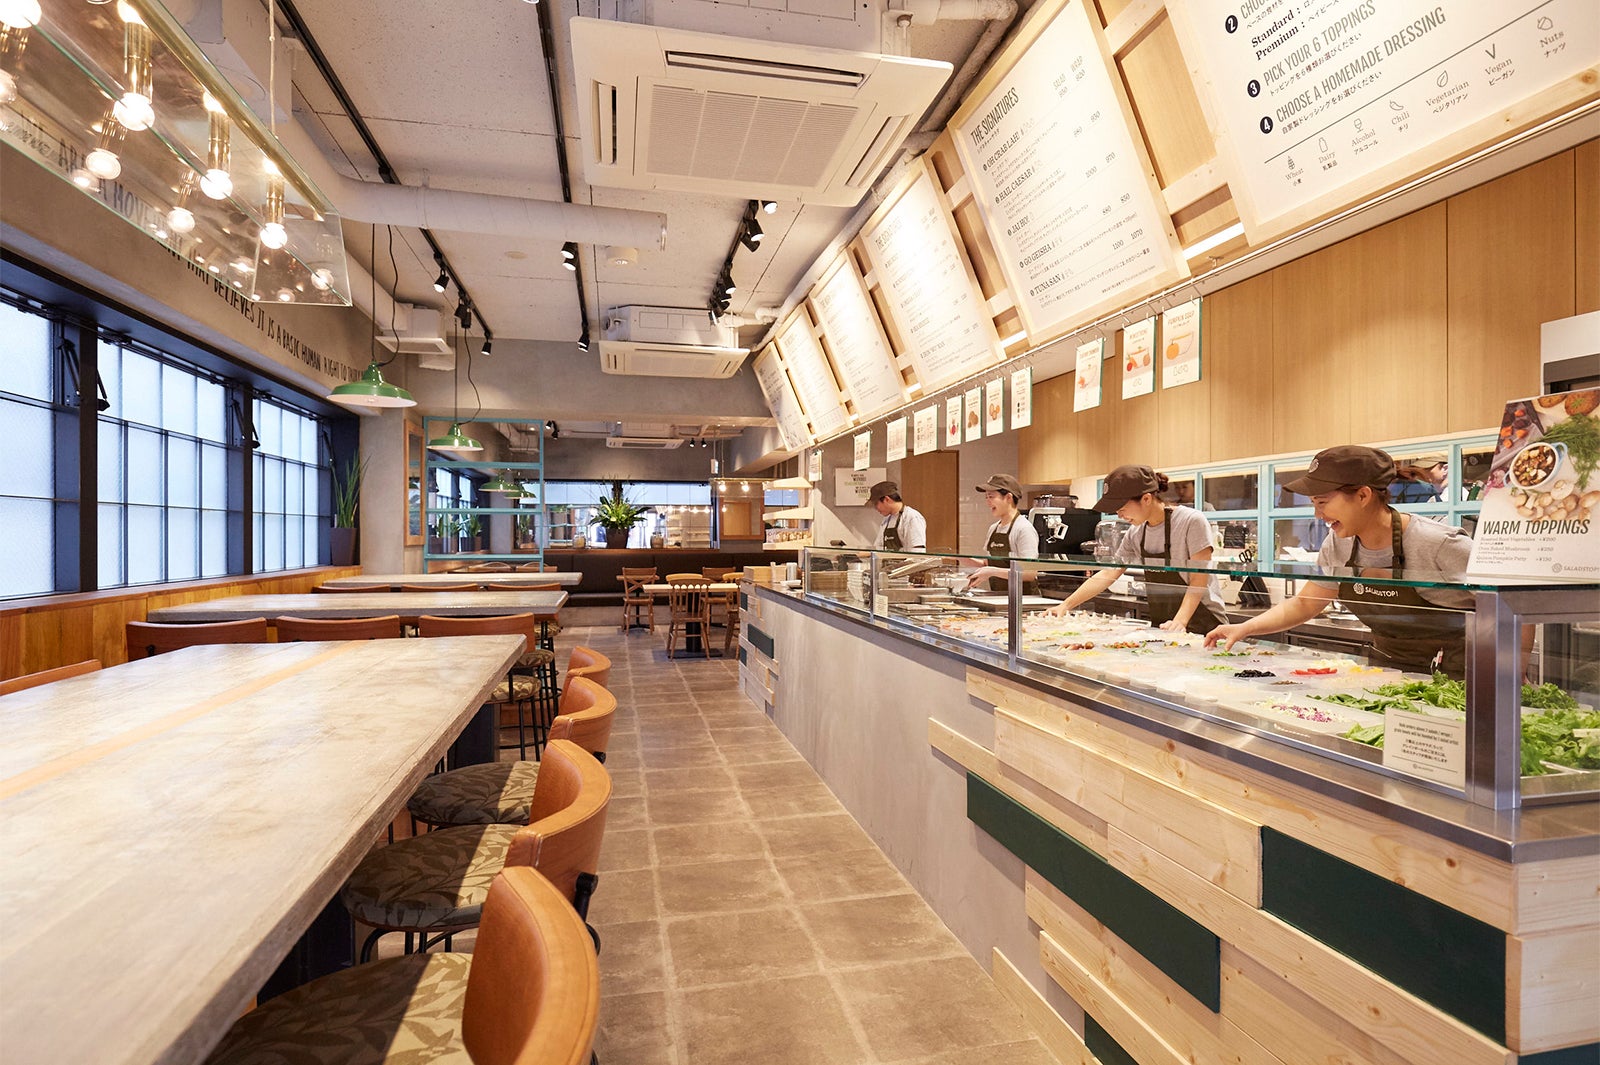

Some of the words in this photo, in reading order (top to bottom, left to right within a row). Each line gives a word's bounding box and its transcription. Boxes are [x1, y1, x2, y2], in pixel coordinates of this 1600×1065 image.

[1251, 9, 1294, 48] Standard
[1539, 30, 1565, 49] Nuts
[1255, 26, 1299, 61] Premium
[1263, 62, 1285, 86] PICK
[1284, 44, 1312, 71] YOUR
[1312, 36, 1321, 53] 6
[1321, 0, 1376, 46] TOPPINGS
[1543, 42, 1567, 58] ナッツ
[1276, 91, 1314, 123] CHOOSE
[1313, 86, 1322, 102] A
[1321, 46, 1383, 95] HOMEMADE
[1383, 6, 1446, 56] DRESSING
[1484, 57, 1513, 77] Vegan
[1425, 80, 1470, 107] Vegetarian
[970, 125, 985, 147] THE
[981, 87, 1019, 135] SIGNATURES
[1391, 111, 1410, 126] Chili
[1351, 129, 1376, 147] Alcohol
[994, 143, 1008, 163] CRAB
[1318, 151, 1336, 164] Dairy
[999, 186, 1012, 201] HAIL
[1010, 168, 1033, 188] CAESAR
[1285, 168, 1304, 181] Wheat
[1023, 256, 1033, 266] GO
[1031, 243, 1052, 260] GEISHA
[1034, 280, 1049, 297] TUNA
[1048, 273, 1062, 287] SAN
[257, 306, 265, 332] IT
[267, 316, 275, 340] IS
[276, 324, 282, 347] A
[282, 328, 300, 360] BASIC
[301, 343, 321, 373] HUMAN
[1483, 520, 1521, 535] WARM
[1525, 518, 1590, 535] TOPPINGS
